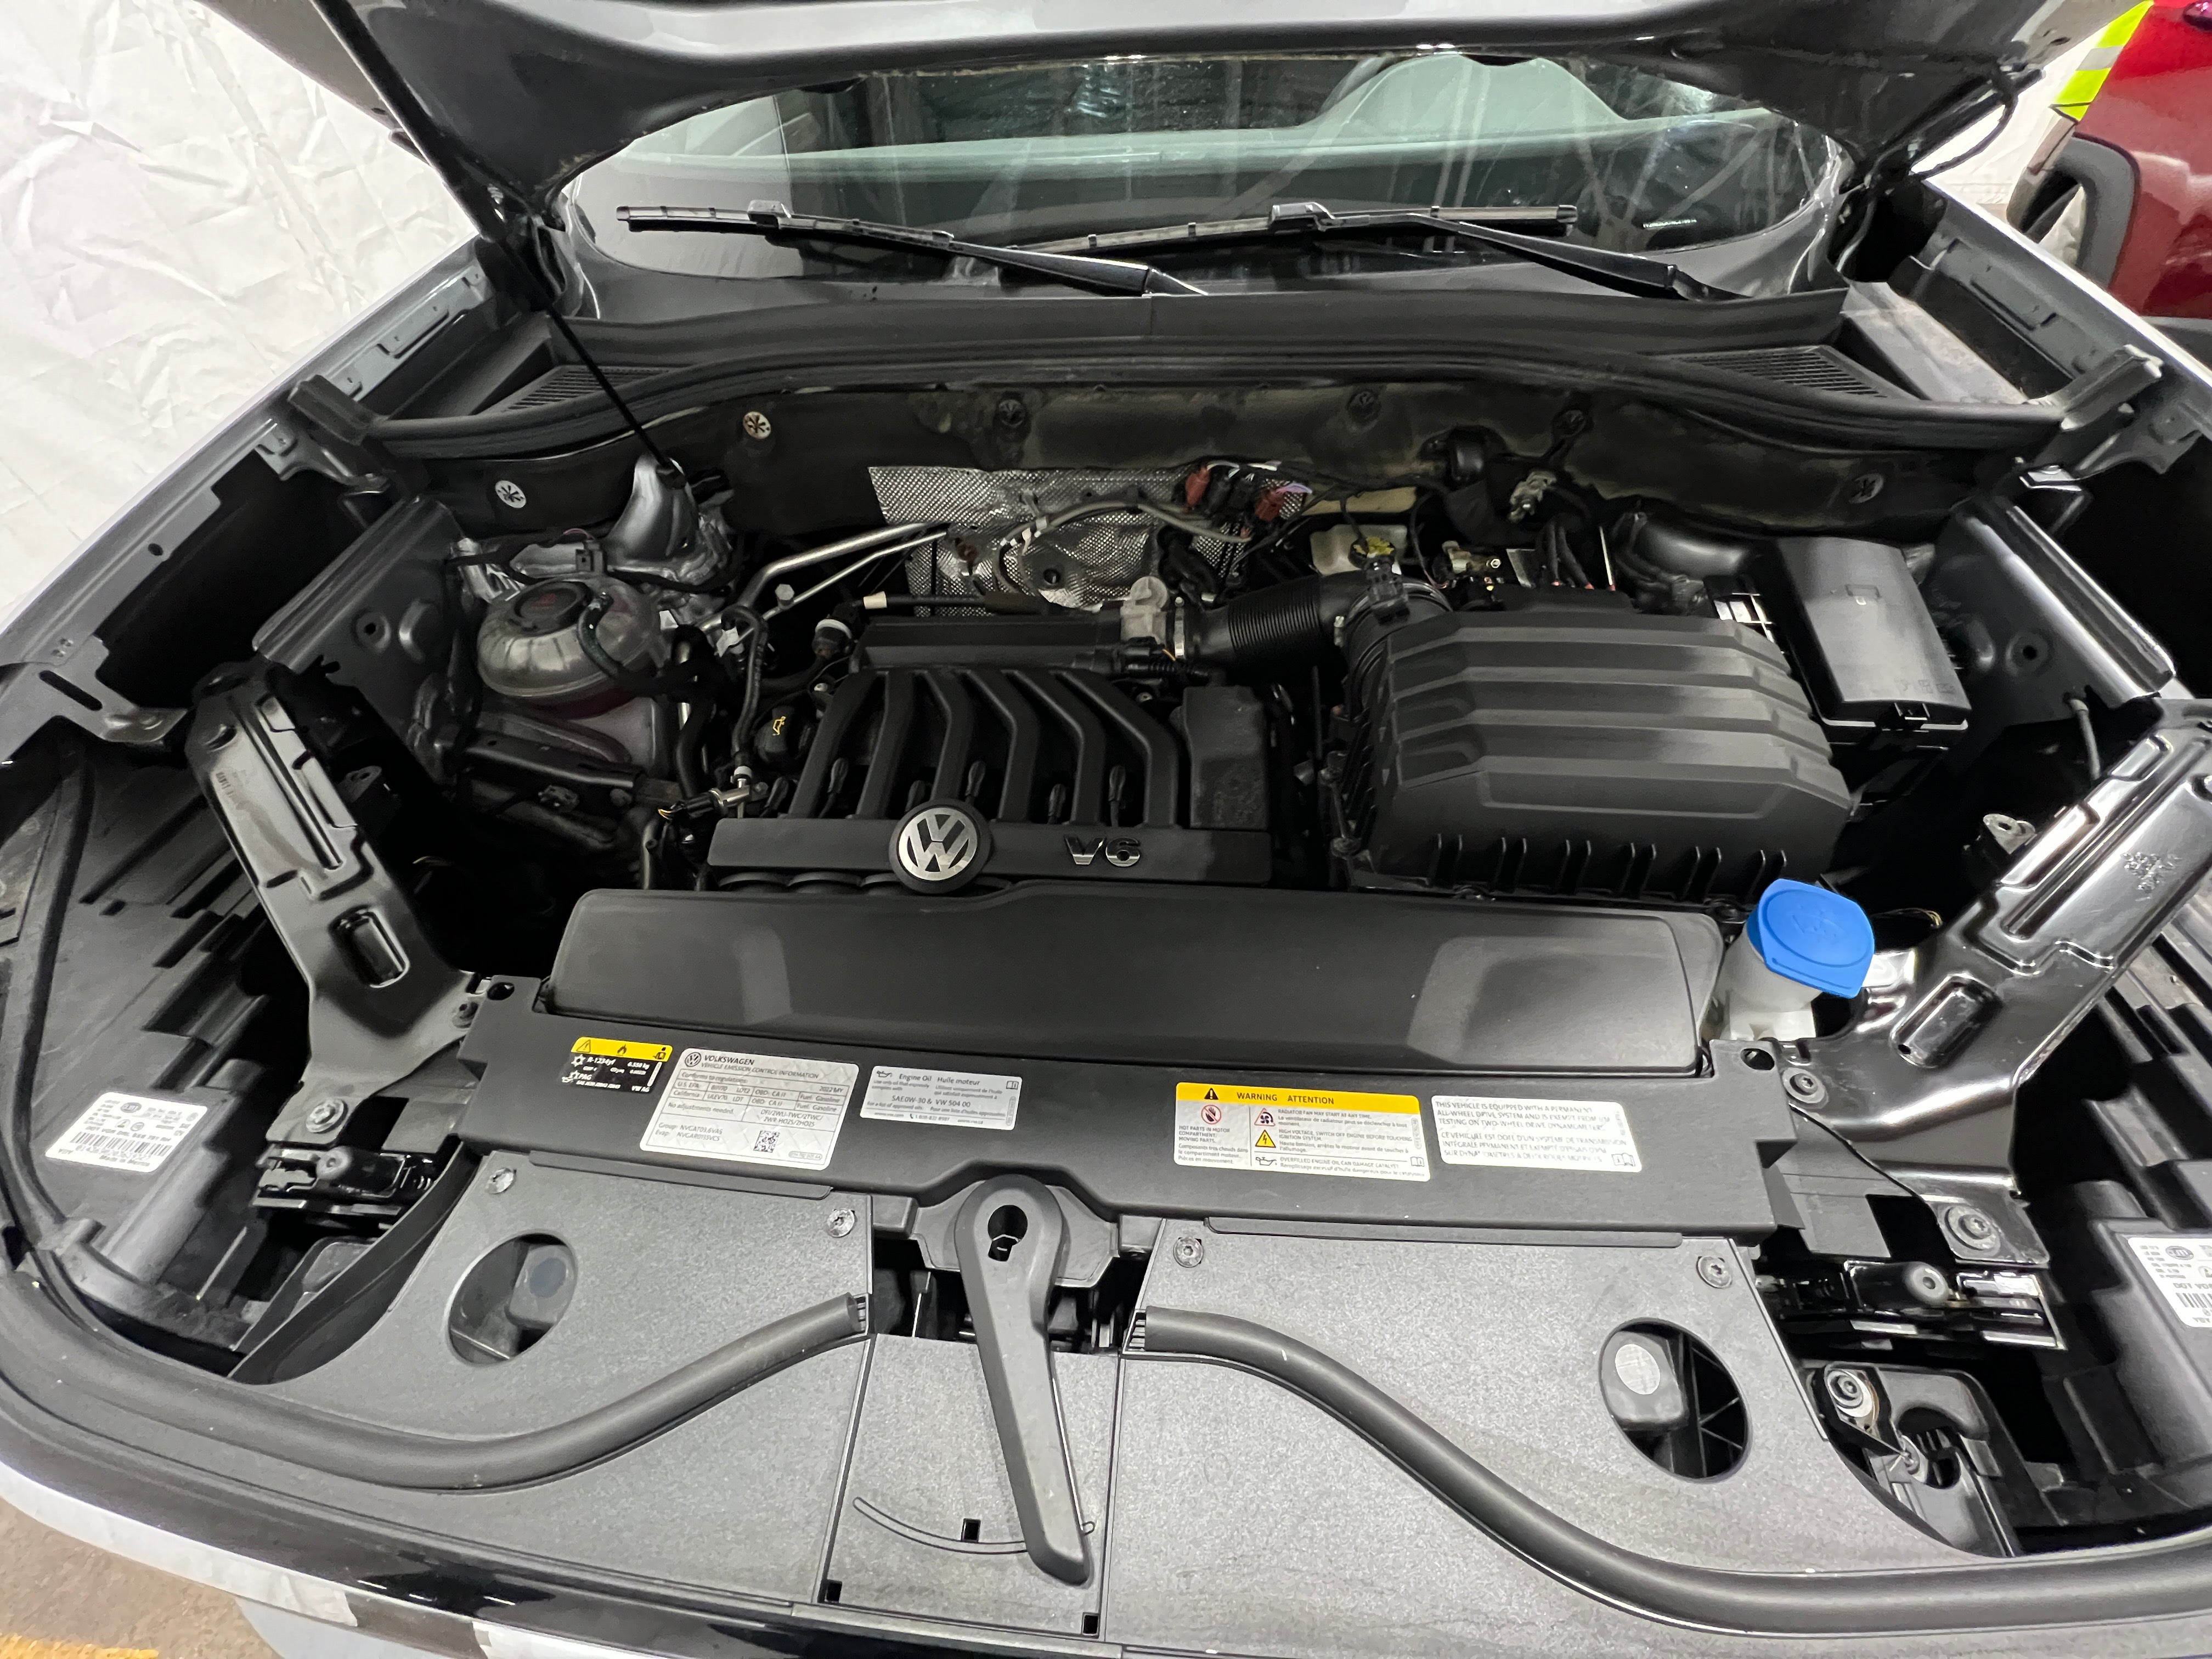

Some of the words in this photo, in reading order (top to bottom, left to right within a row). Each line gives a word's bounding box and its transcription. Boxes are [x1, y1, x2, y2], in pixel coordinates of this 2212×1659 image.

[1063, 835, 1142, 867] V6
[704, 1055, 754, 1065] VOLKSWAGEN
[751, 1066, 778, 1075] CONTROL
[778, 1070, 819, 1079] INFORMATION
[899, 1073, 921, 1082] Engine
[1237, 1092, 1277, 1101] WARNING
[1287, 1095, 1334, 1104] ATTENTION
[676, 1103, 711, 1111] adjustments
[1488, 1103, 1523, 1111] EQUIPPED
[1280, 1162, 1312, 1170] Remplissage
